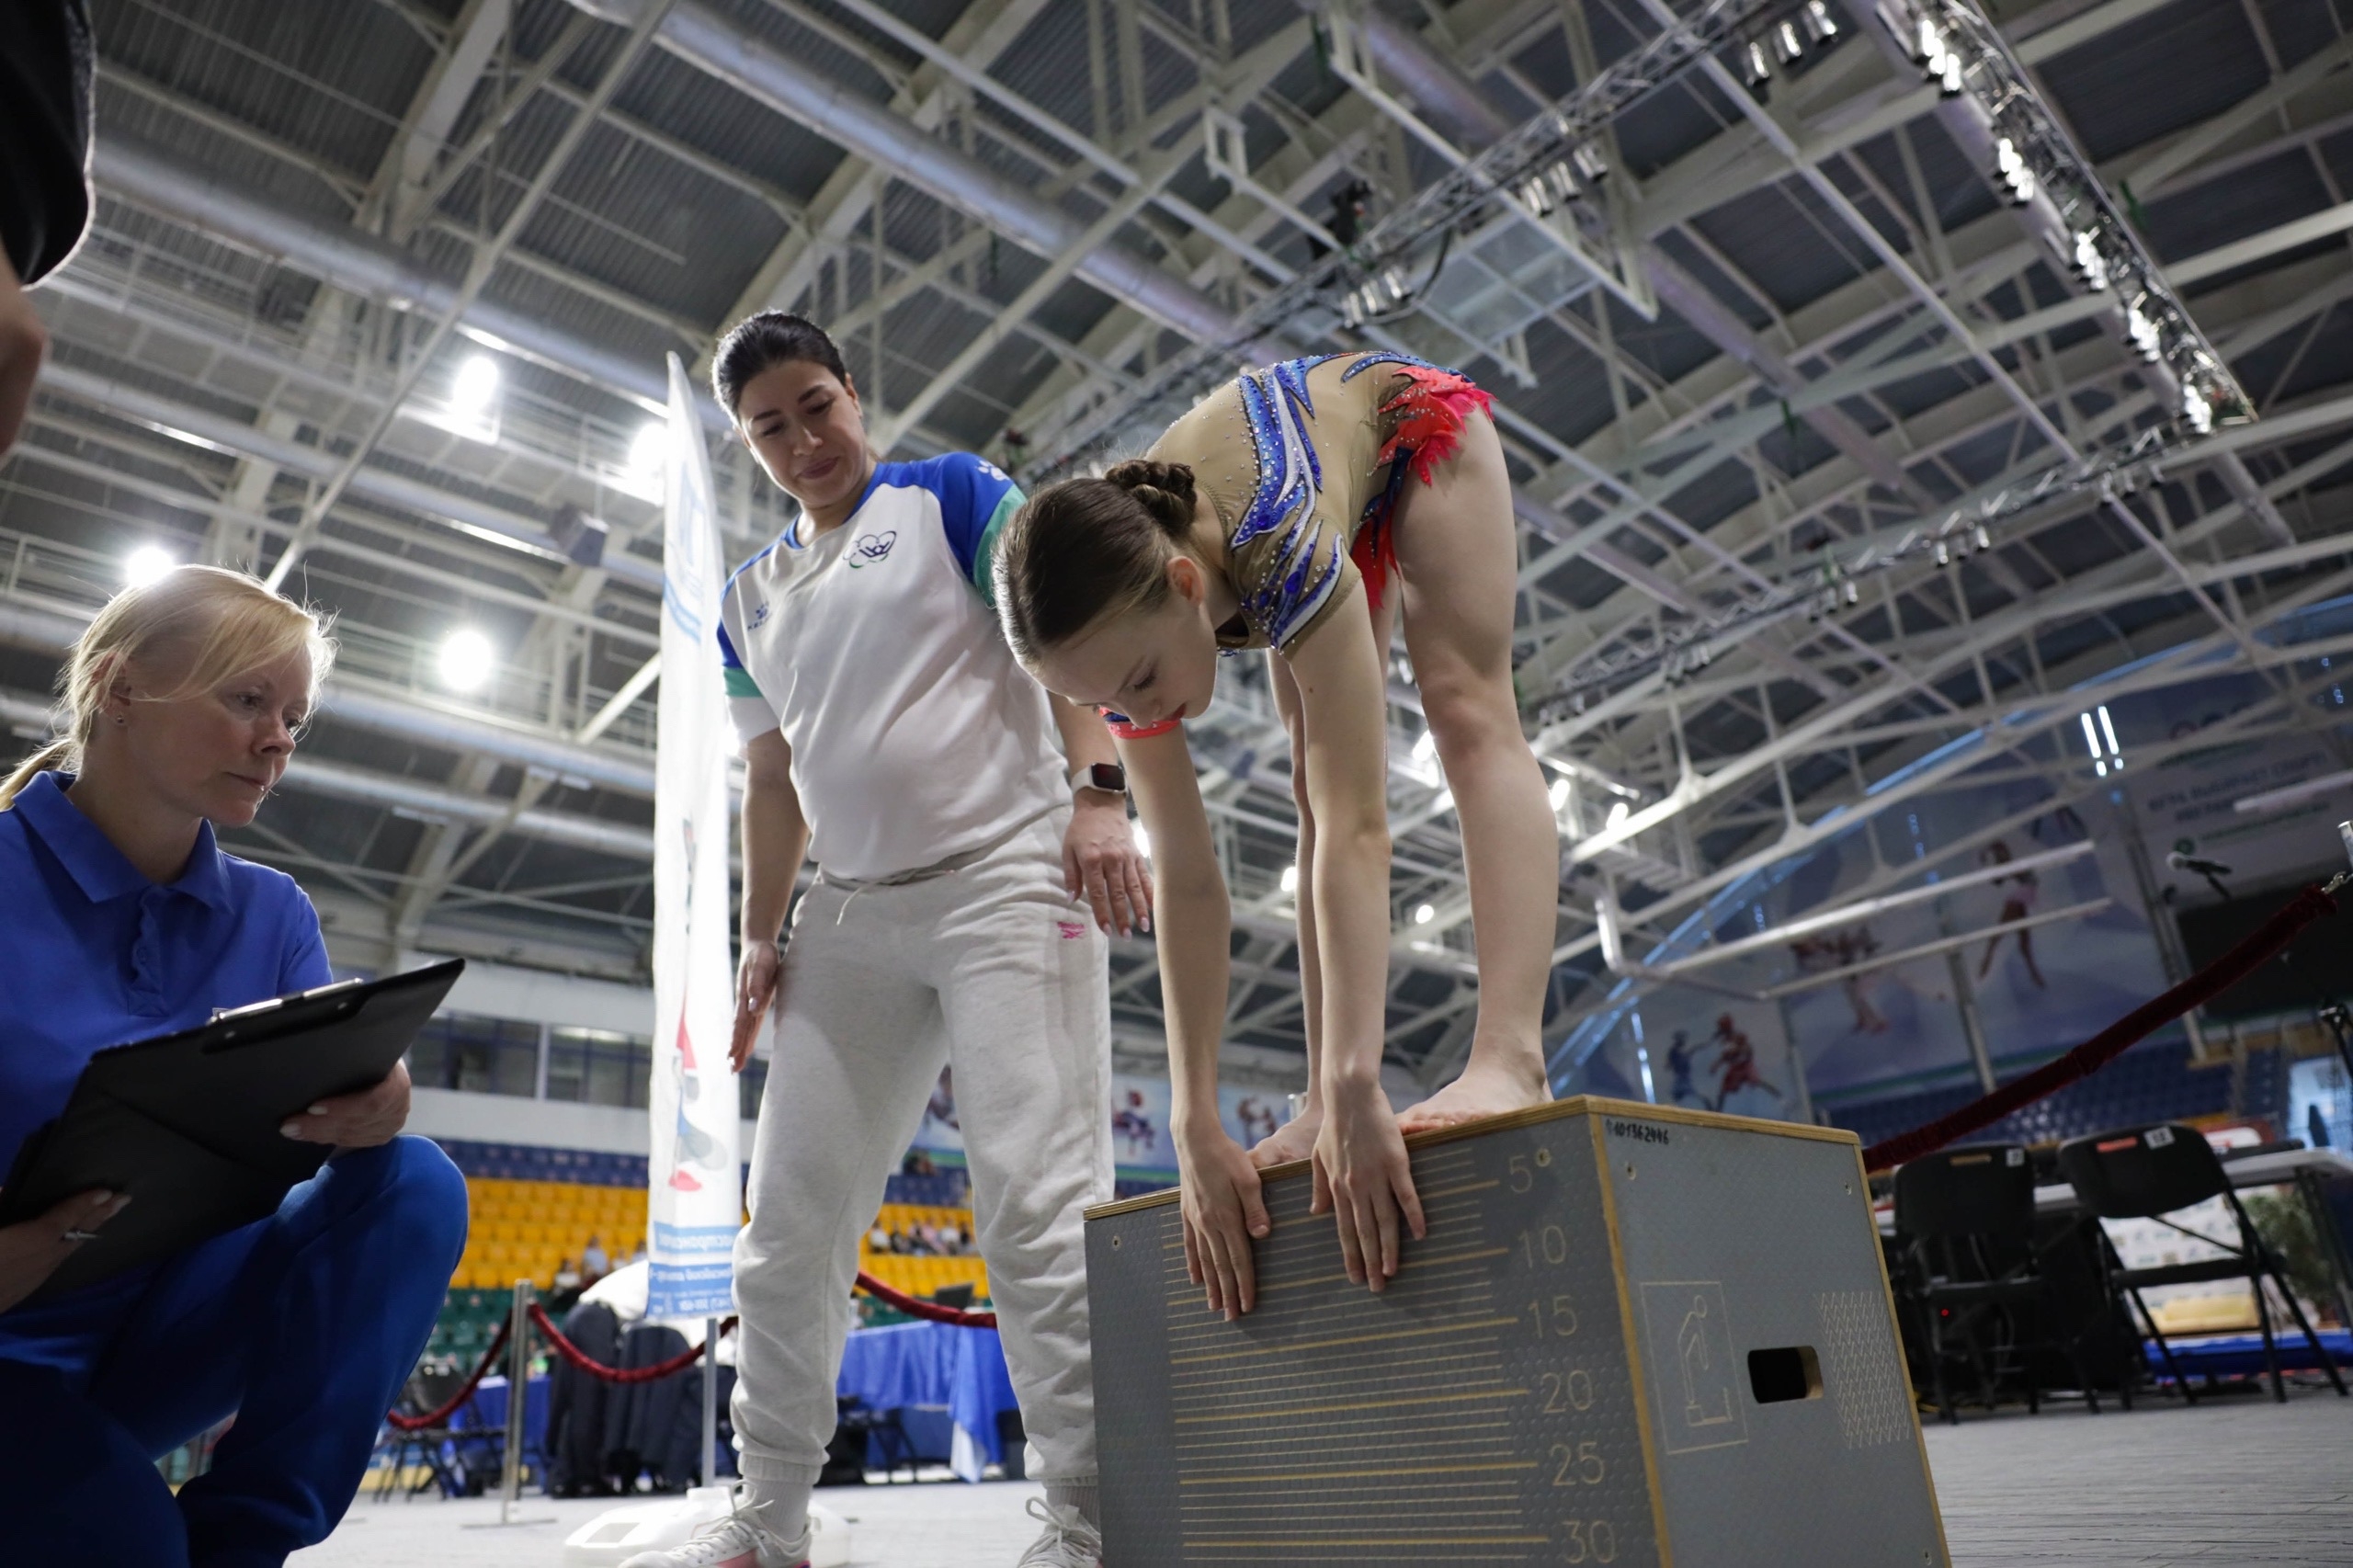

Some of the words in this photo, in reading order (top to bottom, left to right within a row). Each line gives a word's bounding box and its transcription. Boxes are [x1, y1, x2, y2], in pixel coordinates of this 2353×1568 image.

[1509, 1154, 1532, 1193] 5
[1518, 1225, 1566, 1268] 10
[1528, 1295, 1578, 1339] 15
[1540, 1369, 1593, 1414] 20
[1549, 1442, 1605, 1486] 25
[1563, 1520, 1616, 1563] 30
